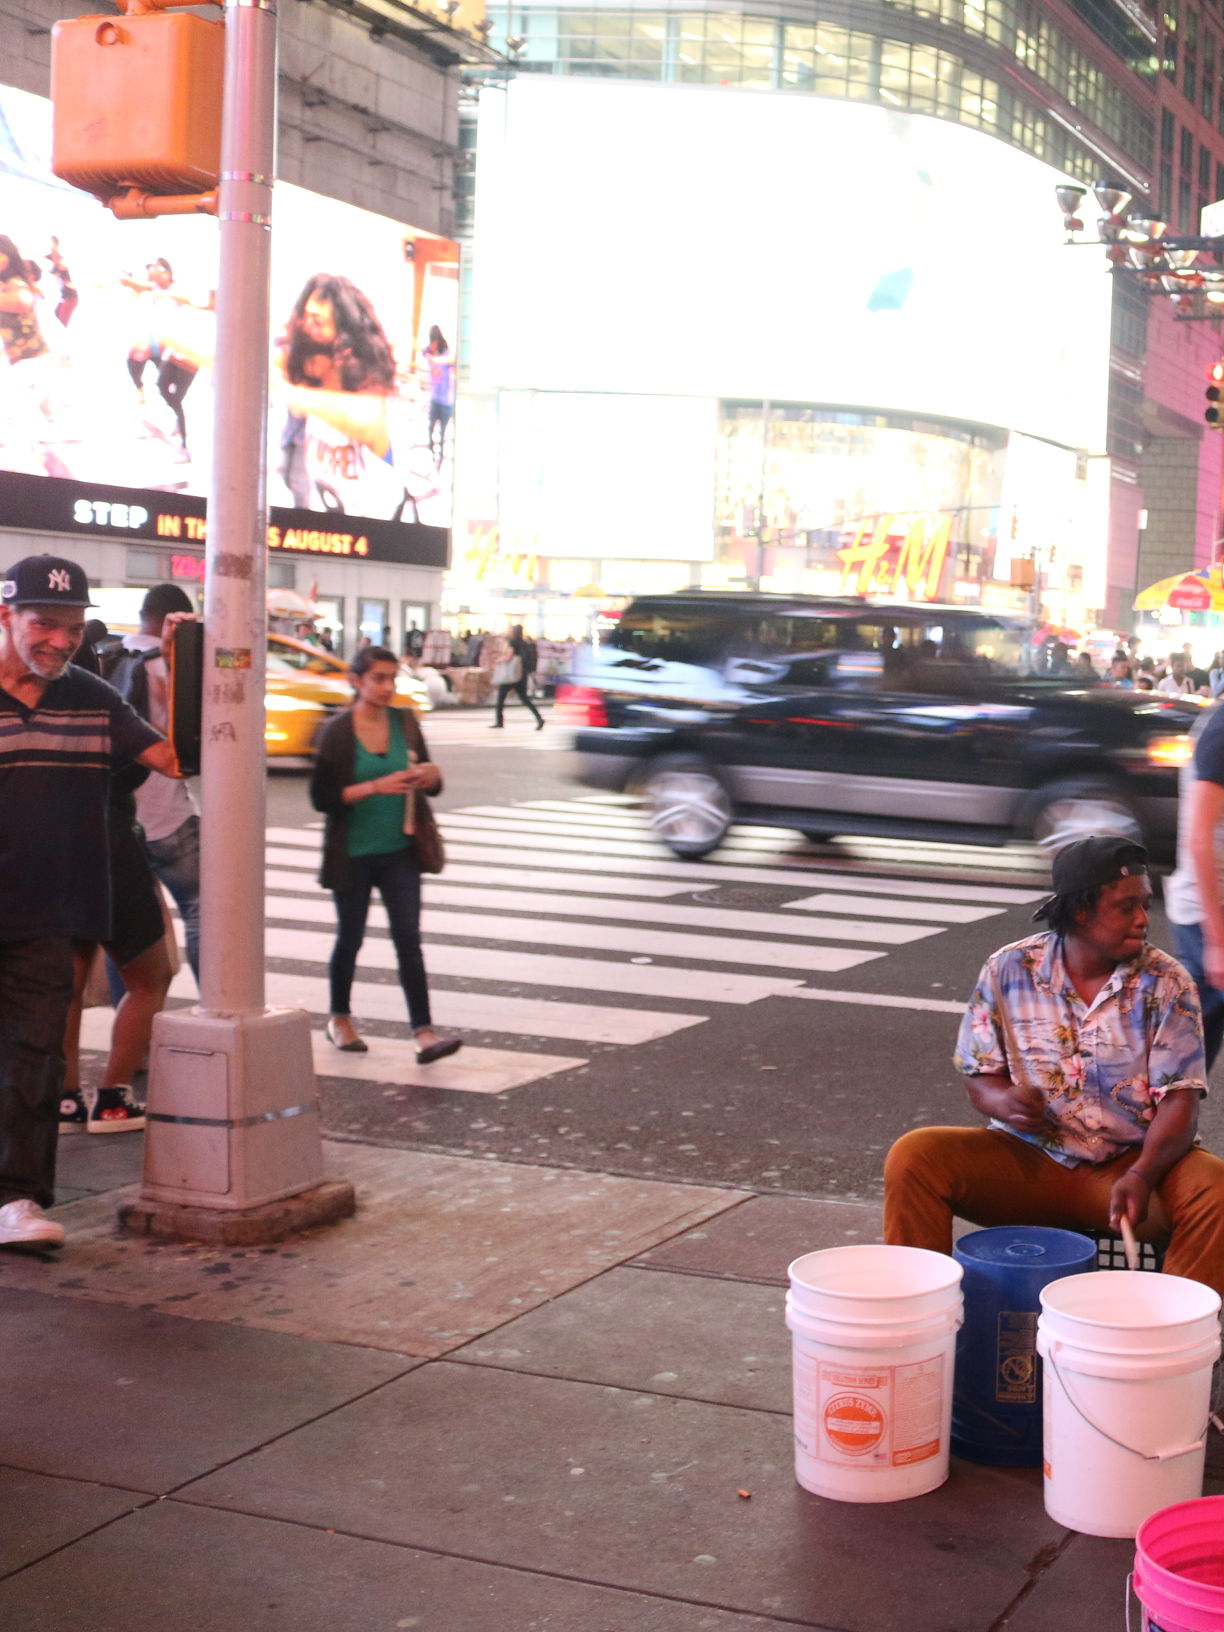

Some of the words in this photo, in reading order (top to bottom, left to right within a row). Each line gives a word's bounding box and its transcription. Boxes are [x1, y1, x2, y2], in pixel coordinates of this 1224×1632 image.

[73, 499, 148, 529] STEP
[156, 514, 181, 537] IN
[283, 529, 353, 554] AUGUST
[354, 536, 368, 556] 4
[837, 515, 952, 602] H&M
